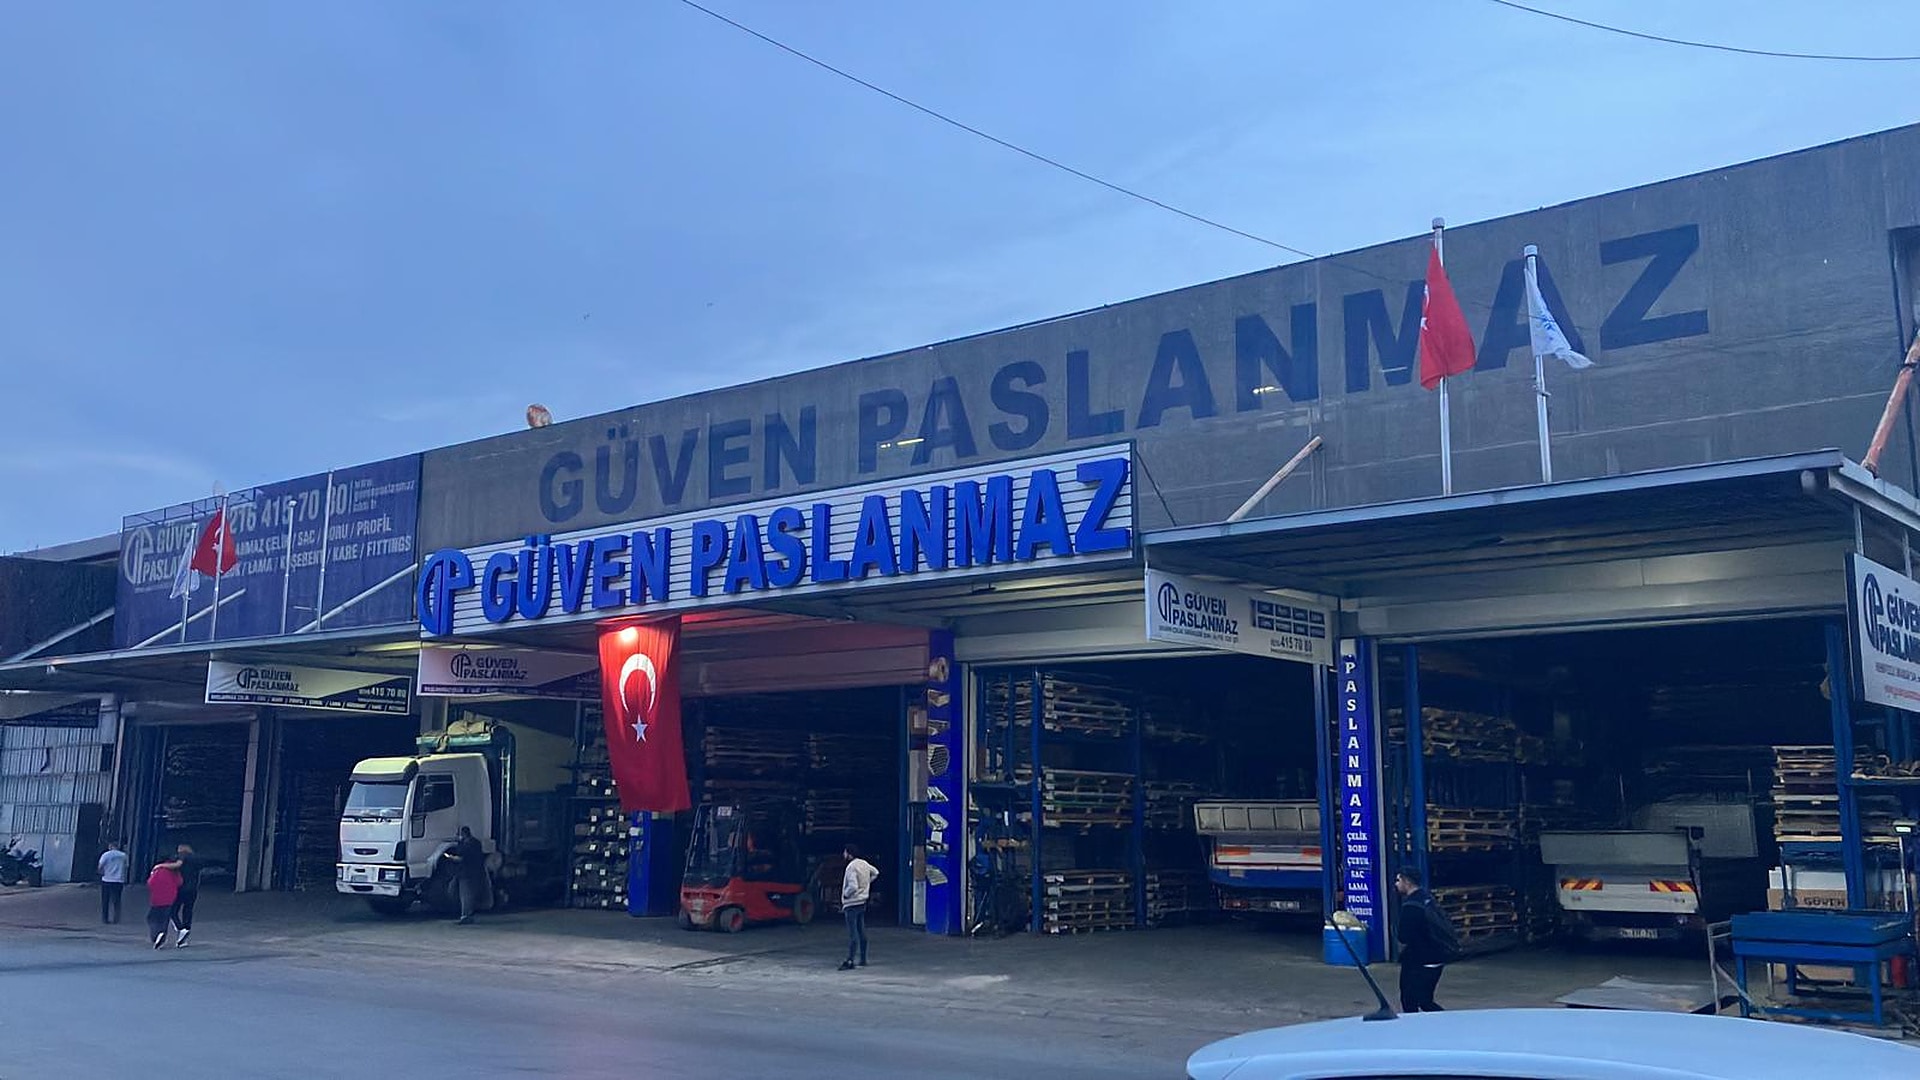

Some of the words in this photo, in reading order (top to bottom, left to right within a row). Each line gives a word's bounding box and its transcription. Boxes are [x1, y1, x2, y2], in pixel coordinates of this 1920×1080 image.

[539, 404, 817, 523] GÜVEN
[857, 224, 1710, 474] PASLANMAZ
[298, 489, 319, 522] 70
[329, 524, 348, 541] ORU
[357, 513, 392, 537] PROFİL
[481, 534, 671, 623] GÜVEN
[690, 457, 1130, 598] PASLANMAZ
[248, 557, 272, 575] LAMA
[332, 543, 358, 561] KARE
[366, 535, 412, 558] FITTINGS
[1172, 609, 1239, 635] PASLANMAZ
[1184, 592, 1227, 616] GÜVEN
[1345, 662, 1362, 826] PASLANMAZ
